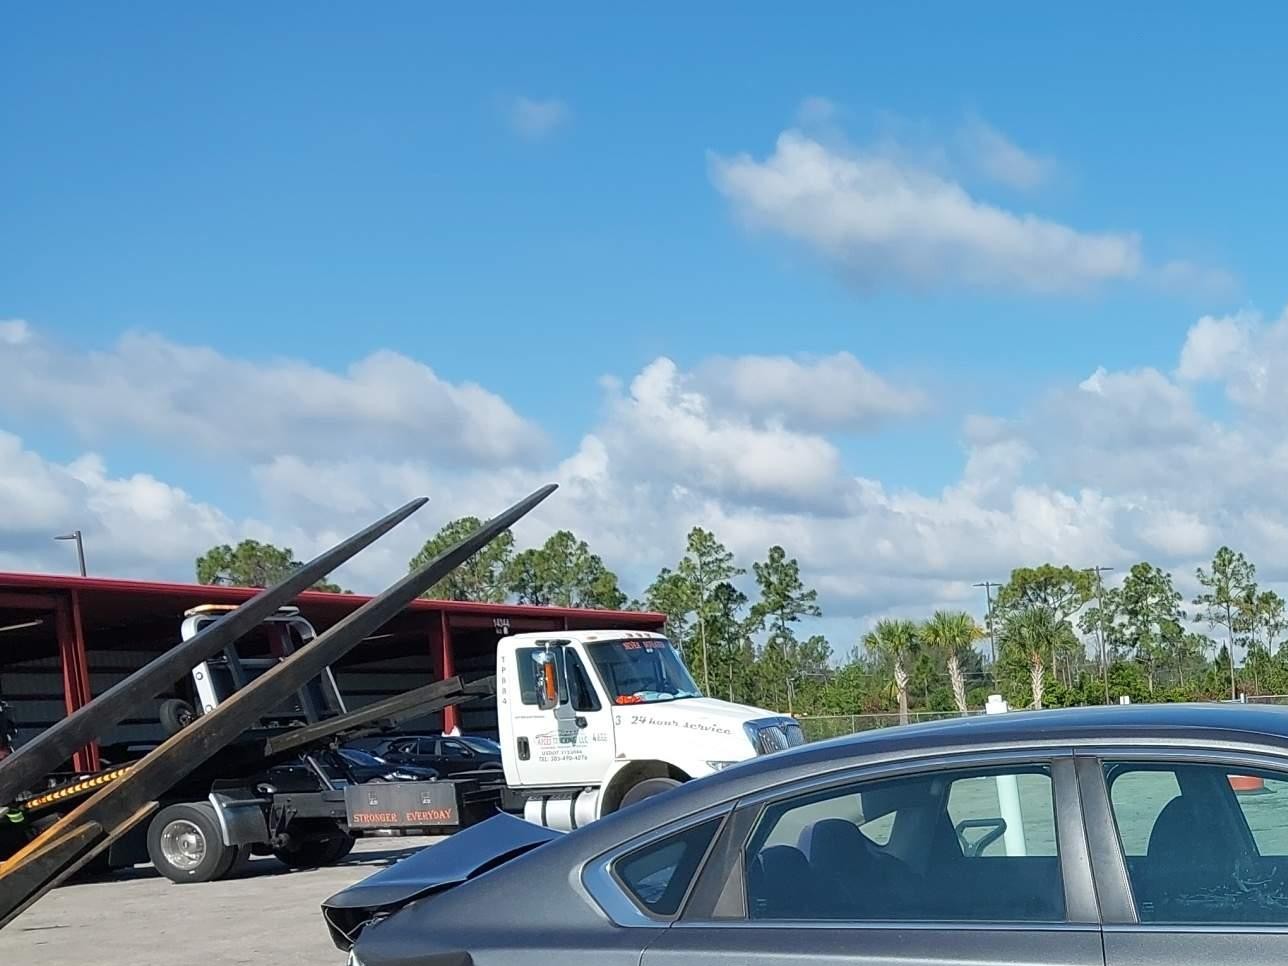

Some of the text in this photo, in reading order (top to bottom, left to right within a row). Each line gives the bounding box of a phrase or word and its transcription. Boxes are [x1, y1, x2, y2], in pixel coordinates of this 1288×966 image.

[631, 715, 735, 735] 24 hour service
[353, 808, 452, 823] STRONGER EVERYDAY
